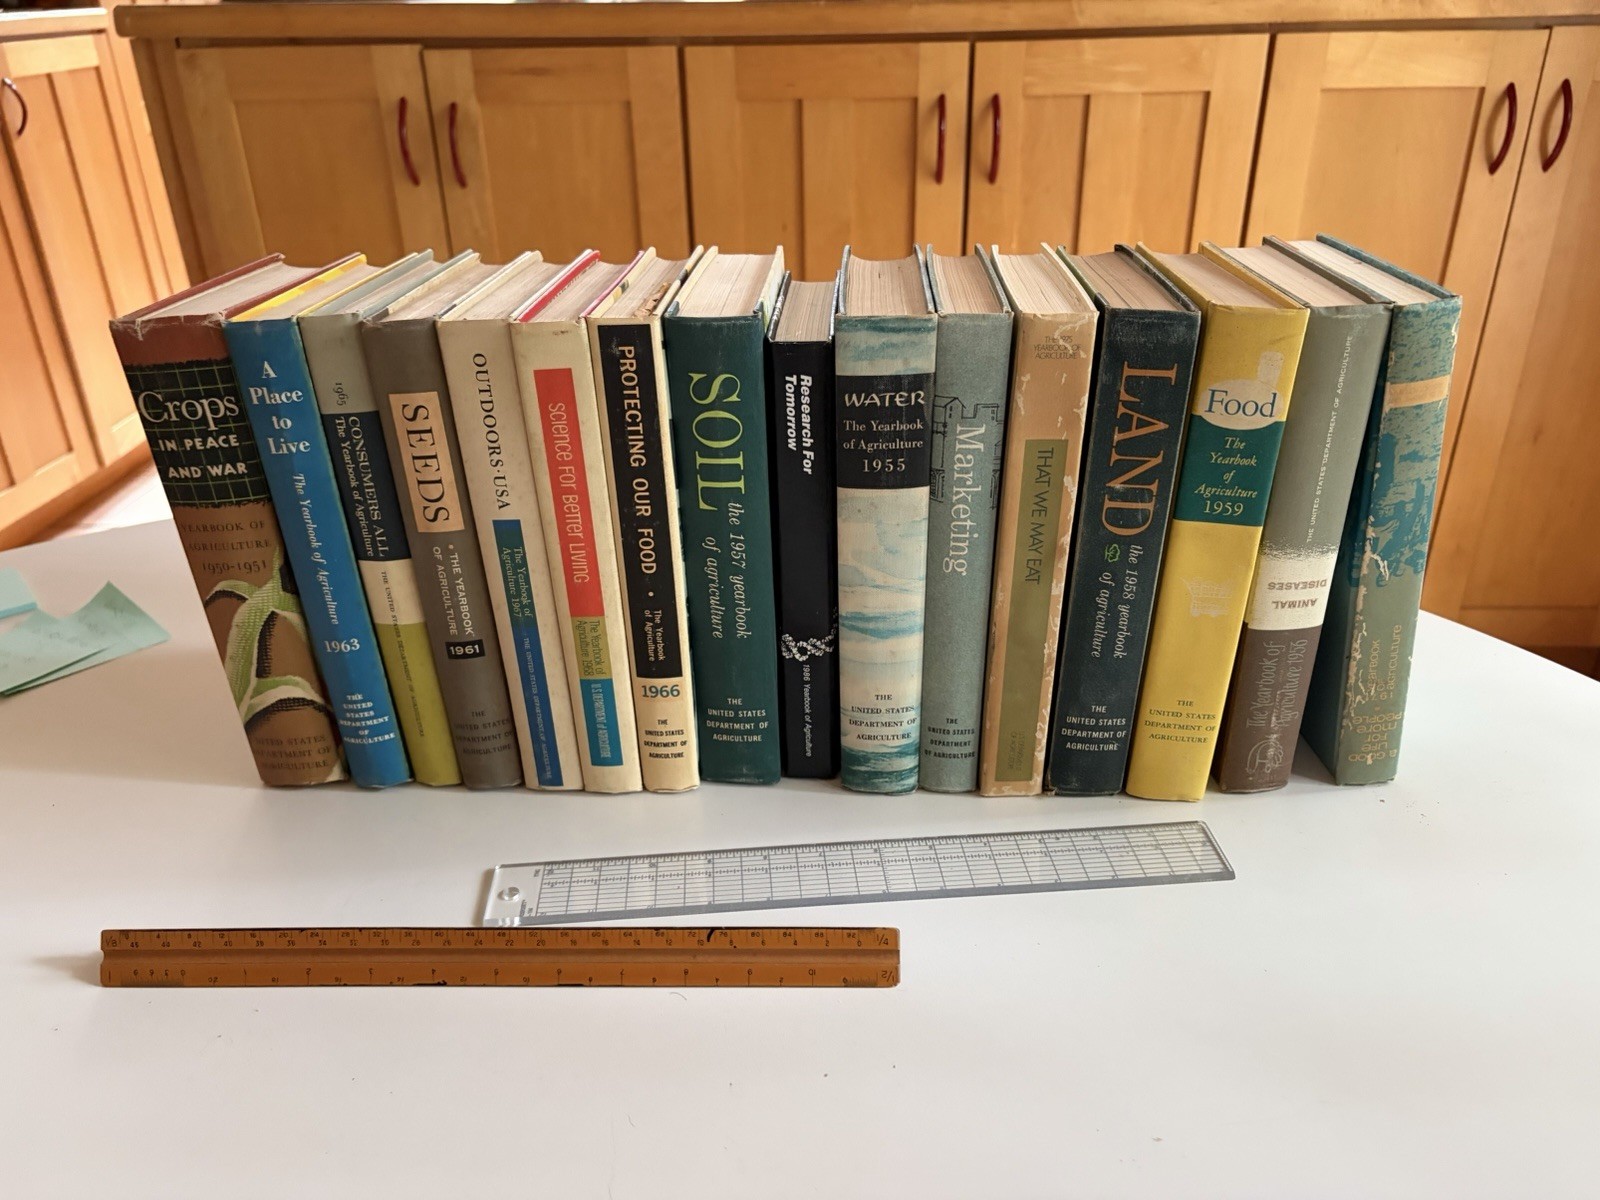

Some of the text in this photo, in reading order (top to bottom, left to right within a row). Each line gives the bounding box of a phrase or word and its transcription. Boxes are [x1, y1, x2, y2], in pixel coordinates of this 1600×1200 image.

[261, 360, 277, 379] A
[248, 387, 304, 405] Place
[333, 382, 349, 406] 1965
[844, 390, 926, 408] WATER
[138, 391, 240, 431] Crops
[1205, 388, 1278, 418] Food
[785, 375, 797, 450] Tomorrow
[271, 415, 292, 429] to
[800, 374, 815, 475] Research For
[843, 419, 924, 432] The Yearbook
[158, 434, 240, 451] IN PEACE
[267, 438, 311, 455] Live
[688, 373, 746, 511] SOIL
[843, 439, 924, 454] of Agriculture
[1101, 361, 1178, 536] LAND
[1224, 436, 1246, 449] The
[402, 404, 450, 524] SEEDS
[618, 345, 657, 574] PROTECTING OUR FOOD
[862, 458, 907, 473] 1955
[1210, 452, 1258, 467] Yearbook
[1310, 497, 1320, 526] UNITED
[1316, 466, 1326, 496] STATES
[1322, 410, 1338, 464] DEPARTMENT
[1334, 397, 1340, 408] OF
[168, 462, 248, 479] AND WAR
[1223, 470, 1236, 484] of
[335, 416, 374, 557] The Yearbook of Agriculture
[349, 416, 390, 557] CONSUMERS ALL
[1194, 483, 1258, 498] Agriculture
[943, 424, 986, 576] Marketing
[1203, 500, 1244, 516] 1959
[1025, 447, 1054, 585] THAT WE MAY EAT
[181, 522, 244, 533] YEARBOOK
[293, 473, 339, 625] The Yearbook of Agriculture
[202, 560, 267, 574] 1950-1951
[727, 502, 752, 639] the 1957 yearbook
[501, 547, 522, 617] Agriculture 1967
[513, 547, 533, 618] The Yearbook of
[701, 536, 726, 639] of agriculture
[1267, 579, 1328, 591] DISEASES
[433, 546, 458, 636] OF AGRICULTURE
[450, 553, 474, 636] THE YEARBOOK
[1112, 544, 1142, 659] the 1958 yearbook
[1271, 597, 1318, 609] ANIMAL
[1091, 571, 1117, 659] of agriculture
[644, 610, 656, 662] of Agriculture
[654, 609, 665, 661] The Yearbook
[324, 638, 361, 653] 1963
[449, 644, 480, 655] 1961
[641, 684, 681, 698] 1966
[1249, 657, 1279, 710] Yearbook
[803, 683, 812, 713] Yearbook
[708, 708, 766, 718] UNITED STATES
[851, 705, 915, 714] UNITED STATES
[1091, 705, 1107, 713] THE
[1149, 709, 1216, 720] UNITED STATES
[706, 720, 769, 730] DEPARTMENT OF
[848, 718, 918, 728] DEPARTMENT OF
[1066, 716, 1126, 726] UNITED STATES
[1144, 720, 1203, 732] DEPARTMENT
[713, 734, 762, 742] AGRICULTURE
[856, 732, 912, 741] AGRICULTURE
[1061, 728, 1127, 738] DEPARTMENT OF
[1148, 734, 1209, 744] AGRICULTURE
[1066, 742, 1118, 751] AGRICULTURE
